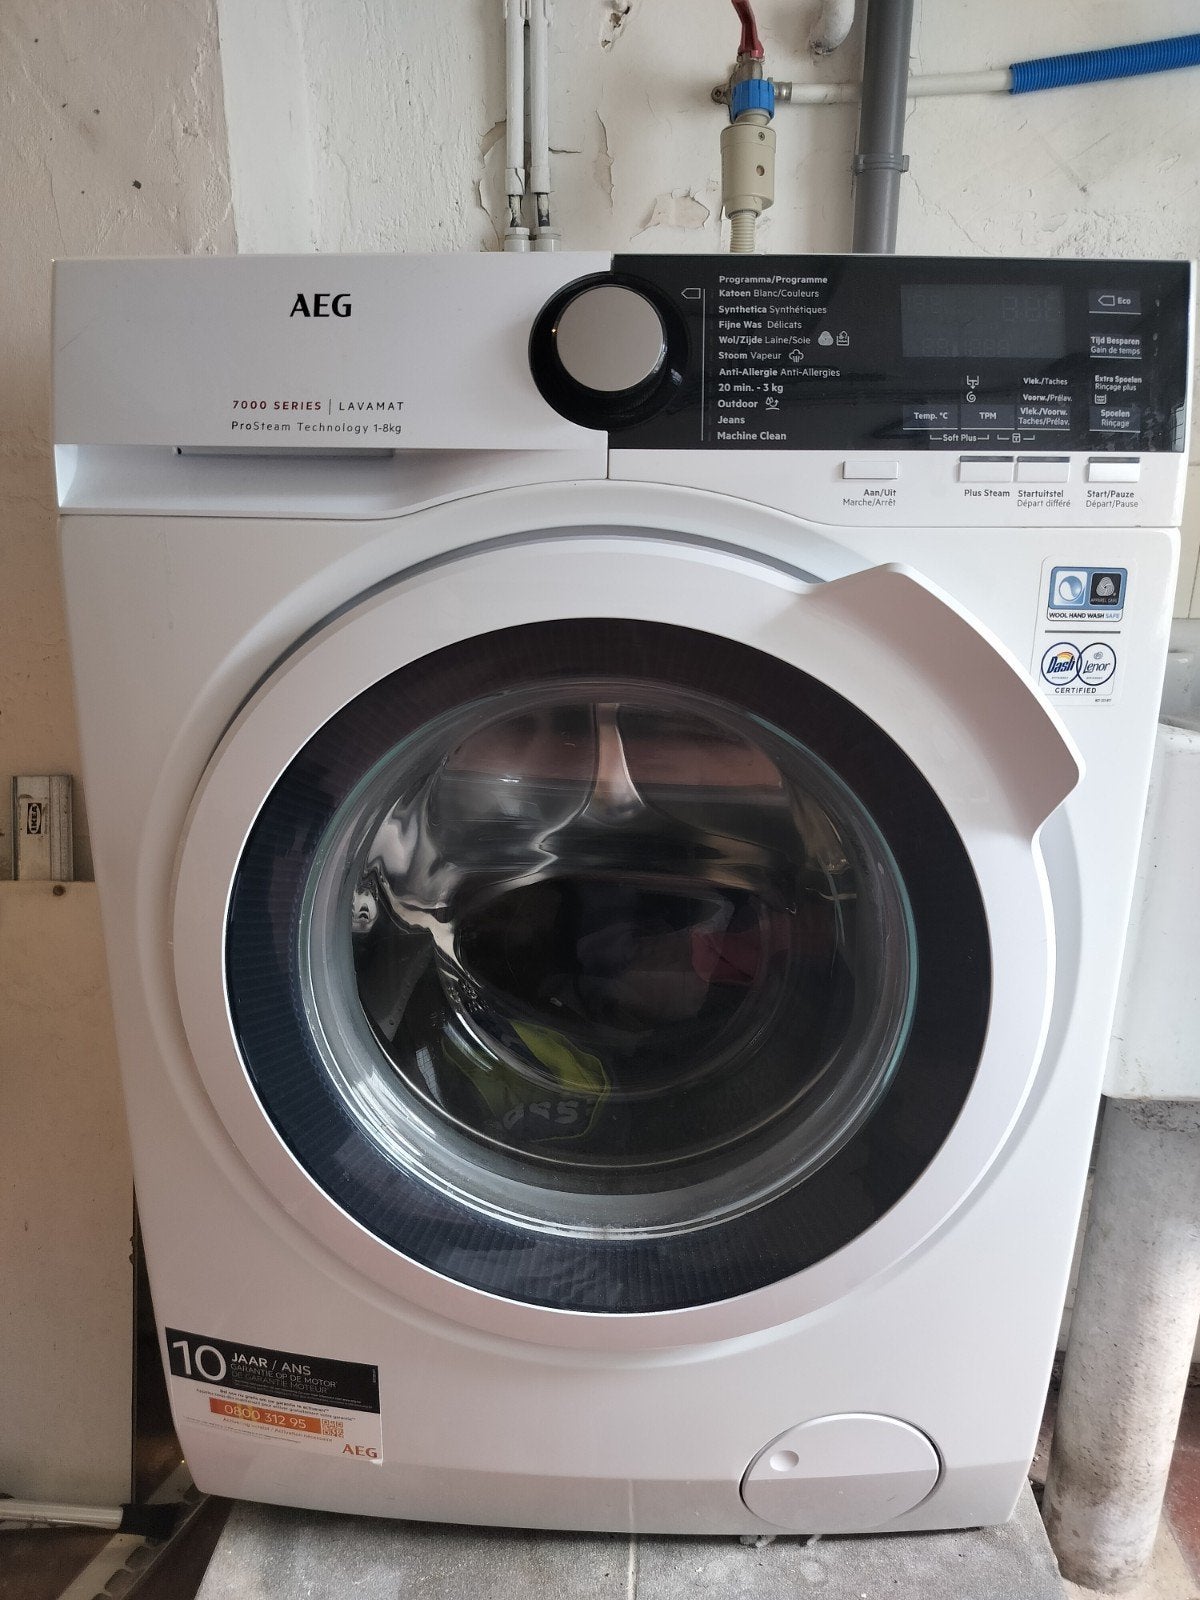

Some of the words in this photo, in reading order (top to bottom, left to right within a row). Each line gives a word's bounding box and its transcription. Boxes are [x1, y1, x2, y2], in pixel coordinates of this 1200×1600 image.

[719, 275, 828, 285] Programma/Programme
[753, 290, 819, 298] Blanc/Couleurs
[290, 293, 352, 318] AEG
[1117, 297, 1131, 305] Eco
[718, 306, 767, 315] Synthetica
[769, 305, 827, 315] Synthétiques
[719, 321, 741, 330] Fijne
[767, 320, 802, 329] Délicats
[719, 336, 763, 345] Wol/Zijde
[764, 336, 811, 344] Laine/Soie
[1090, 336, 1105, 346] Tijd
[1106, 337, 1140, 347] Besparen
[1090, 346, 1107, 354] Gain
[1109, 346, 1117, 354] de
[1118, 347, 1141, 355] temps
[718, 352, 748, 360] Stoom
[750, 352, 781, 361] Vapeur
[719, 368, 778, 378] Anti-Allergie
[780, 368, 841, 378] Anti-Allergies
[1023, 377, 1068, 386] Vlek./Taches
[1095, 375, 1112, 383] Extra
[1113, 375, 1142, 385] Spoelen
[718, 383, 731, 391] 20
[733, 383, 754, 391] min.
[763, 383, 769, 391] 3
[771, 383, 784, 394] kg
[1095, 383, 1121, 392] Rinçage
[1122, 383, 1137, 392] plus
[232, 399, 267, 411] 7000
[274, 399, 322, 411] SERIES
[339, 400, 404, 412] LAVAMAT
[718, 400, 758, 408] Outdoor
[979, 412, 997, 420] TPM
[1020, 407, 1068, 416] Vlek./Voorw.
[1100, 409, 1130, 418] Spoelen
[717, 416, 746, 424] Jeans
[913, 412, 938, 422] Temp.
[231, 420, 291, 432] ProSteam
[297, 421, 369, 435] Technology
[373, 422, 402, 435] 1-8kg
[1101, 418, 1130, 429] Rinçage
[717, 432, 757, 440] Machine
[759, 432, 787, 440] Clean
[942, 433, 958, 441] Soft
[960, 433, 977, 442] Plus
[863, 488, 897, 497] Aan/Uit
[964, 488, 982, 497] Plus
[984, 489, 1010, 498] Steam
[1017, 488, 1064, 499] Startuitstel
[1087, 489, 1135, 499] Start/Pauze
[843, 498, 896, 508] Marche/Arrêt
[1017, 498, 1044, 509] Départ
[1046, 498, 1071, 509] différé
[1085, 499, 1139, 510] Départ/Pause
[1046, 655, 1076, 674] Dash
[1083, 660, 1111, 674] Lenor
[172, 1340, 227, 1381] 10
[231, 1352, 268, 1369] JAAR
[281, 1362, 312, 1376] ANS
[230, 1363, 274, 1378] GARANTIE
[276, 1371, 288, 1380] OP
[290, 1374, 301, 1382] DE
[224, 1404, 261, 1421] 0800
[264, 1412, 286, 1426] 312
[289, 1417, 307, 1429] 95
[342, 1443, 378, 1458] AEG
